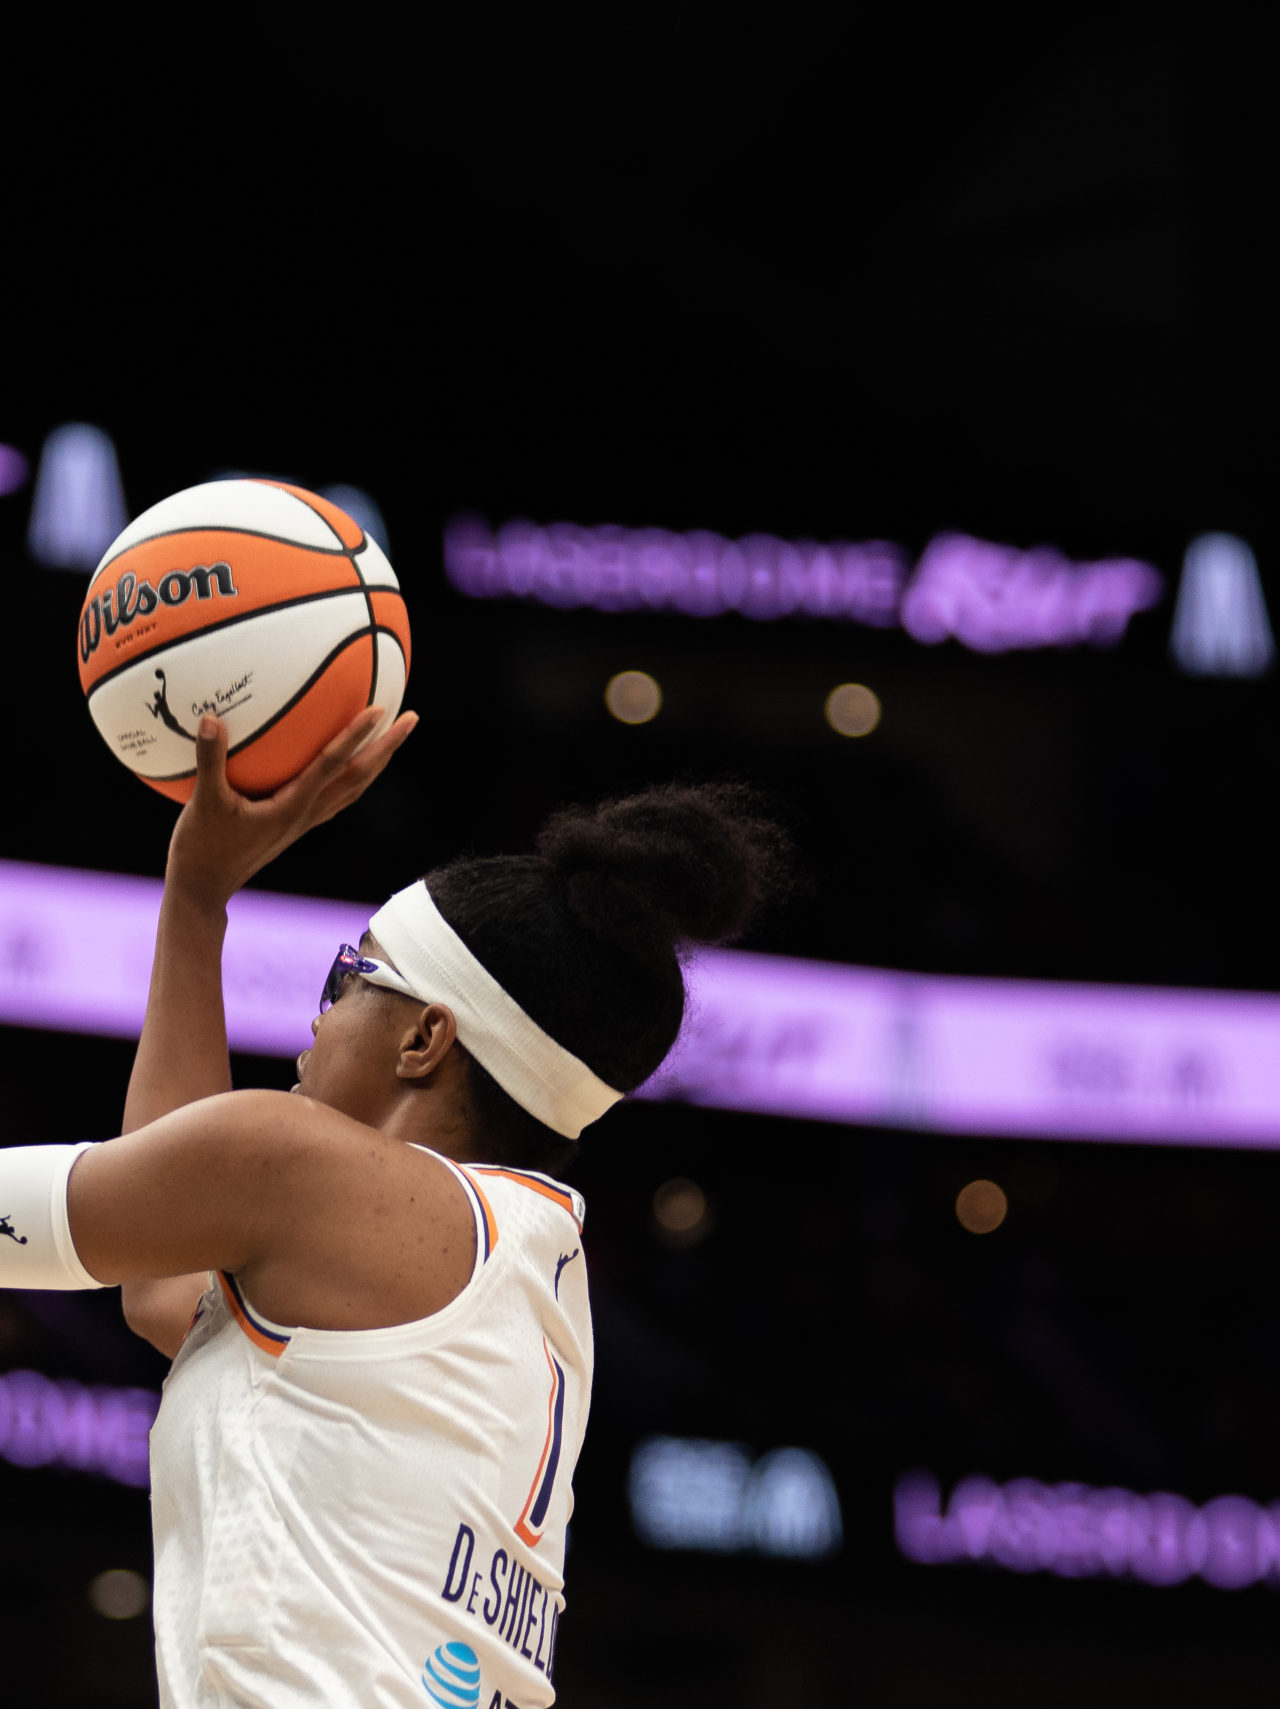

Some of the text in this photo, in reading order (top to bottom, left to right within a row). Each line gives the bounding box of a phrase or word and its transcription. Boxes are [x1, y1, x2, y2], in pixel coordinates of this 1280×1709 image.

[80, 561, 238, 664] Wilson
[444, 517, 906, 628] LASERDOME
[513, 1335, 566, 1548] 1
[894, 1468, 1280, 1589] LASERDO
